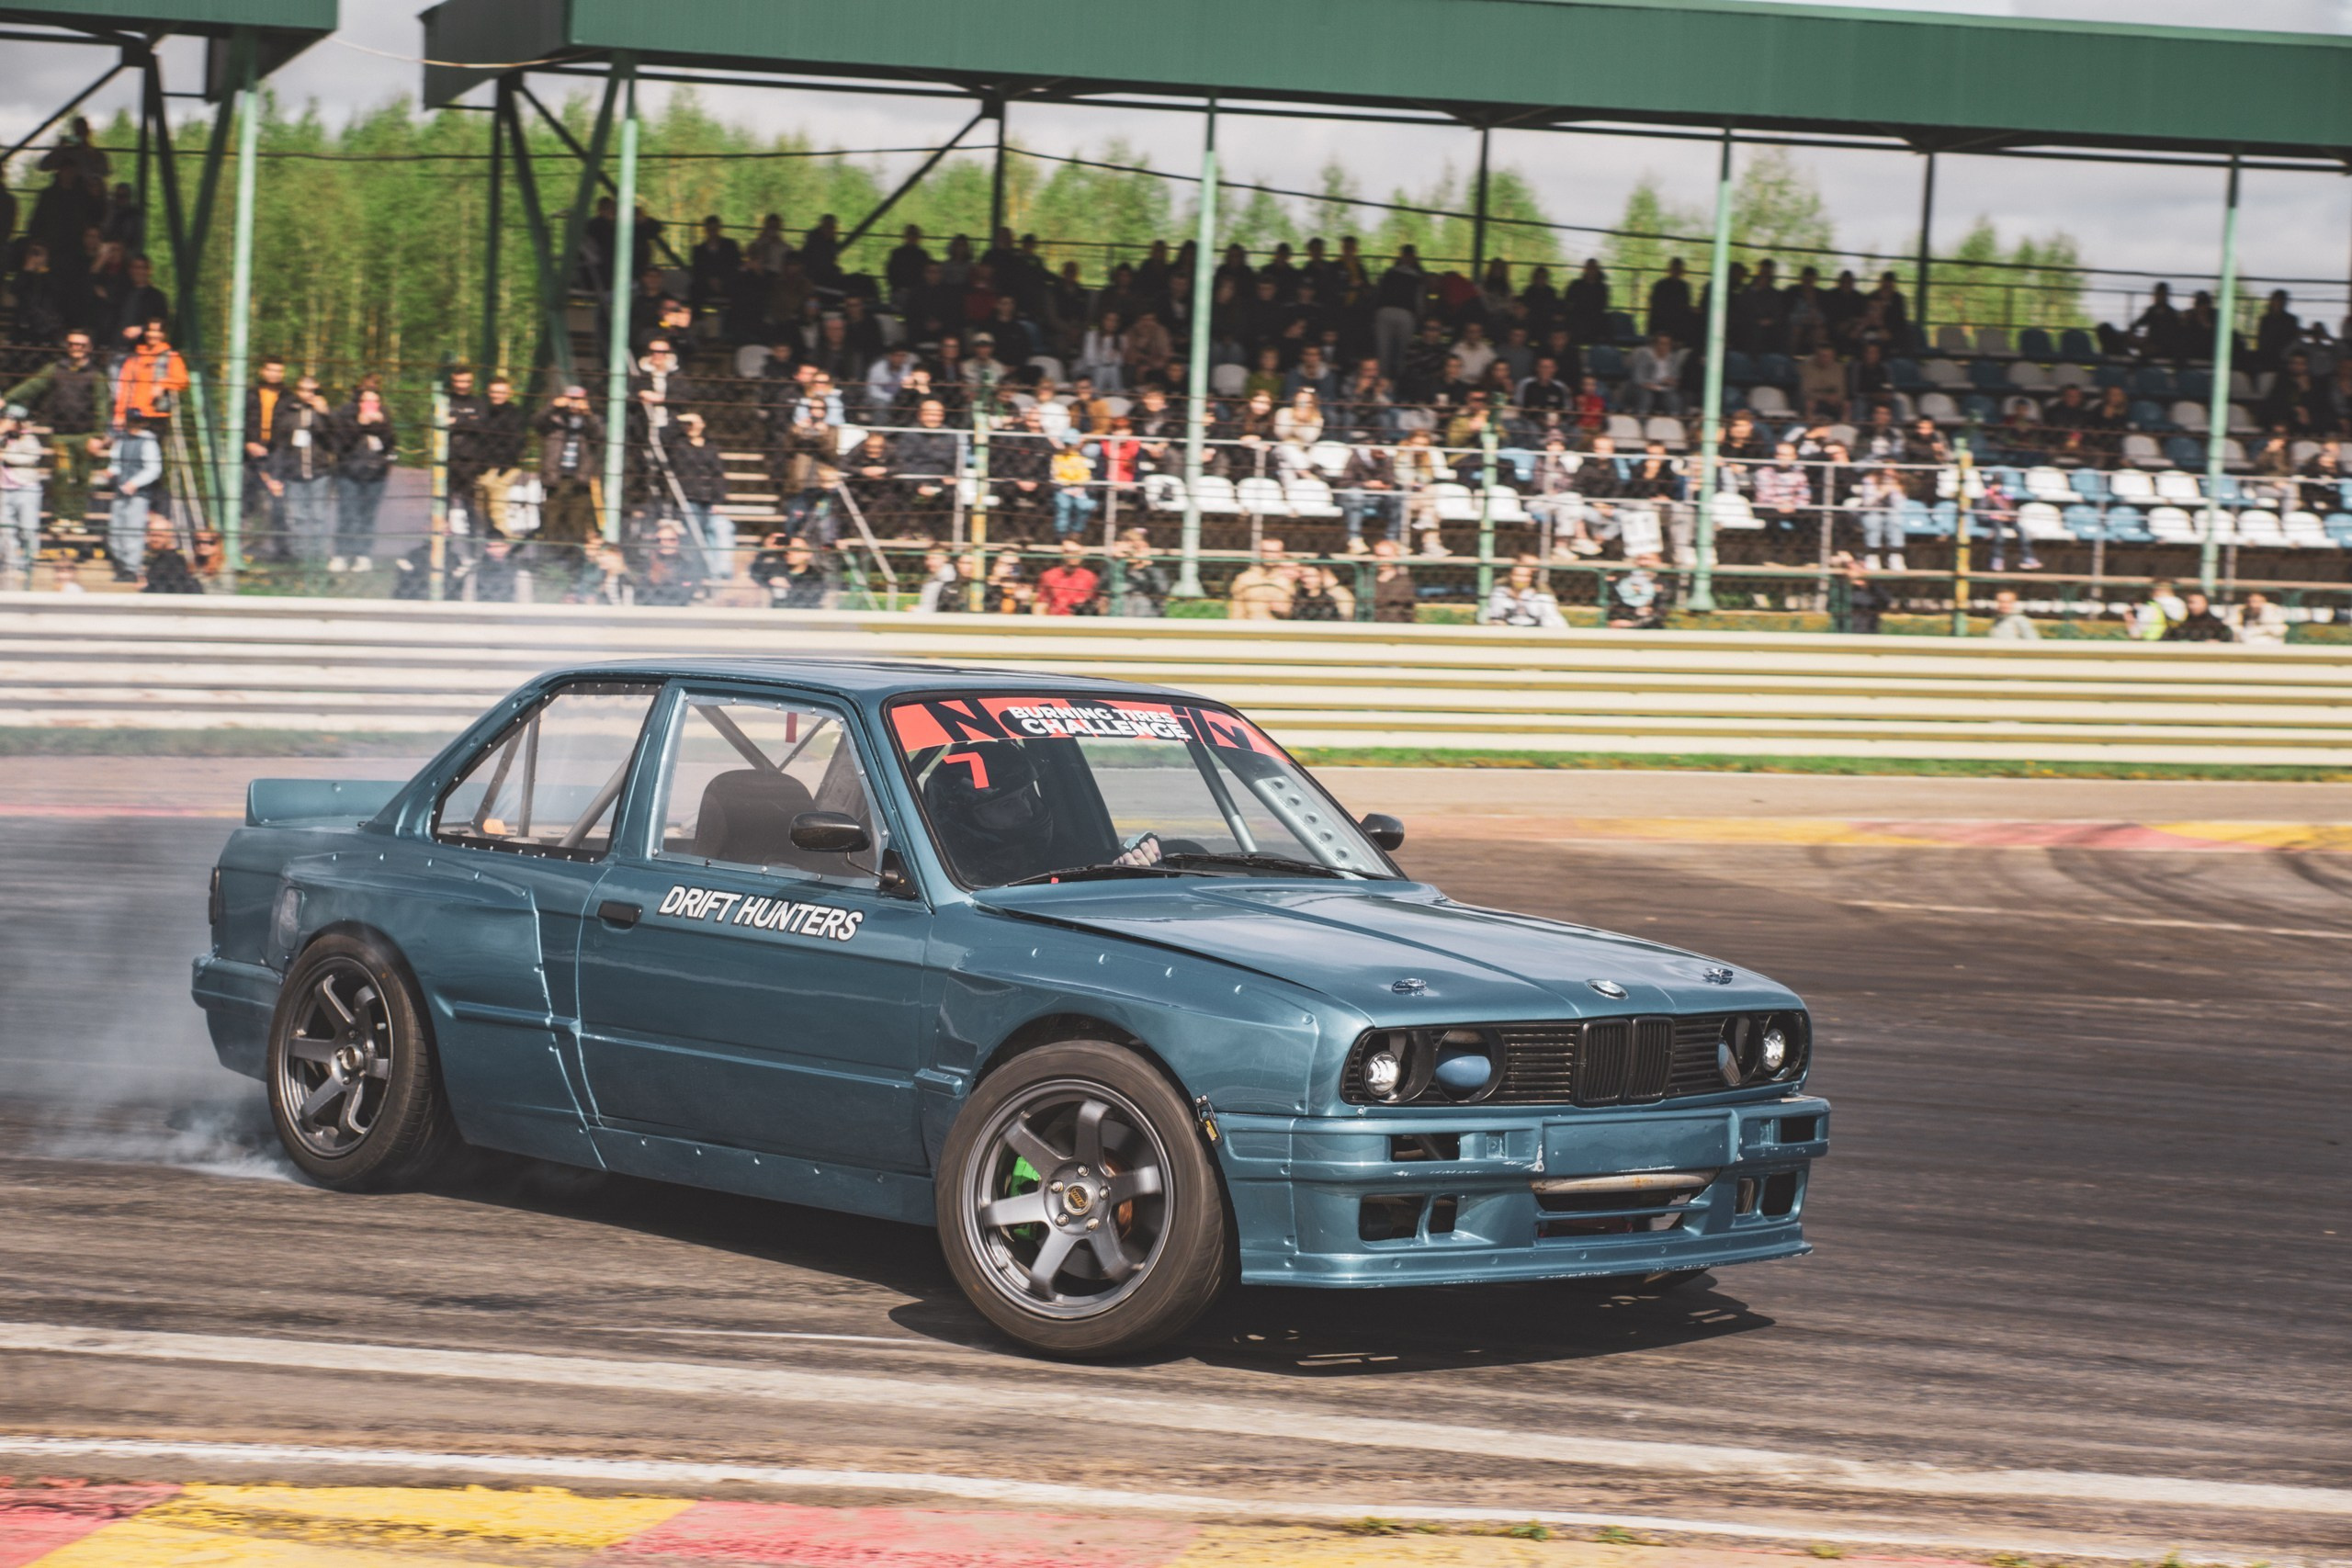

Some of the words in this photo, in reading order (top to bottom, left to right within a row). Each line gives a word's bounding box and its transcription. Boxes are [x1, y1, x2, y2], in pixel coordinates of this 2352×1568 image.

[1007, 706, 1113, 720] BURNING
[1112, 708, 1177, 724] TIRES
[1021, 718, 1193, 739] CHALLENGE
[942, 751, 989, 789] 7
[659, 886, 742, 922] DRIFT
[733, 896, 864, 941] HUNTERS
